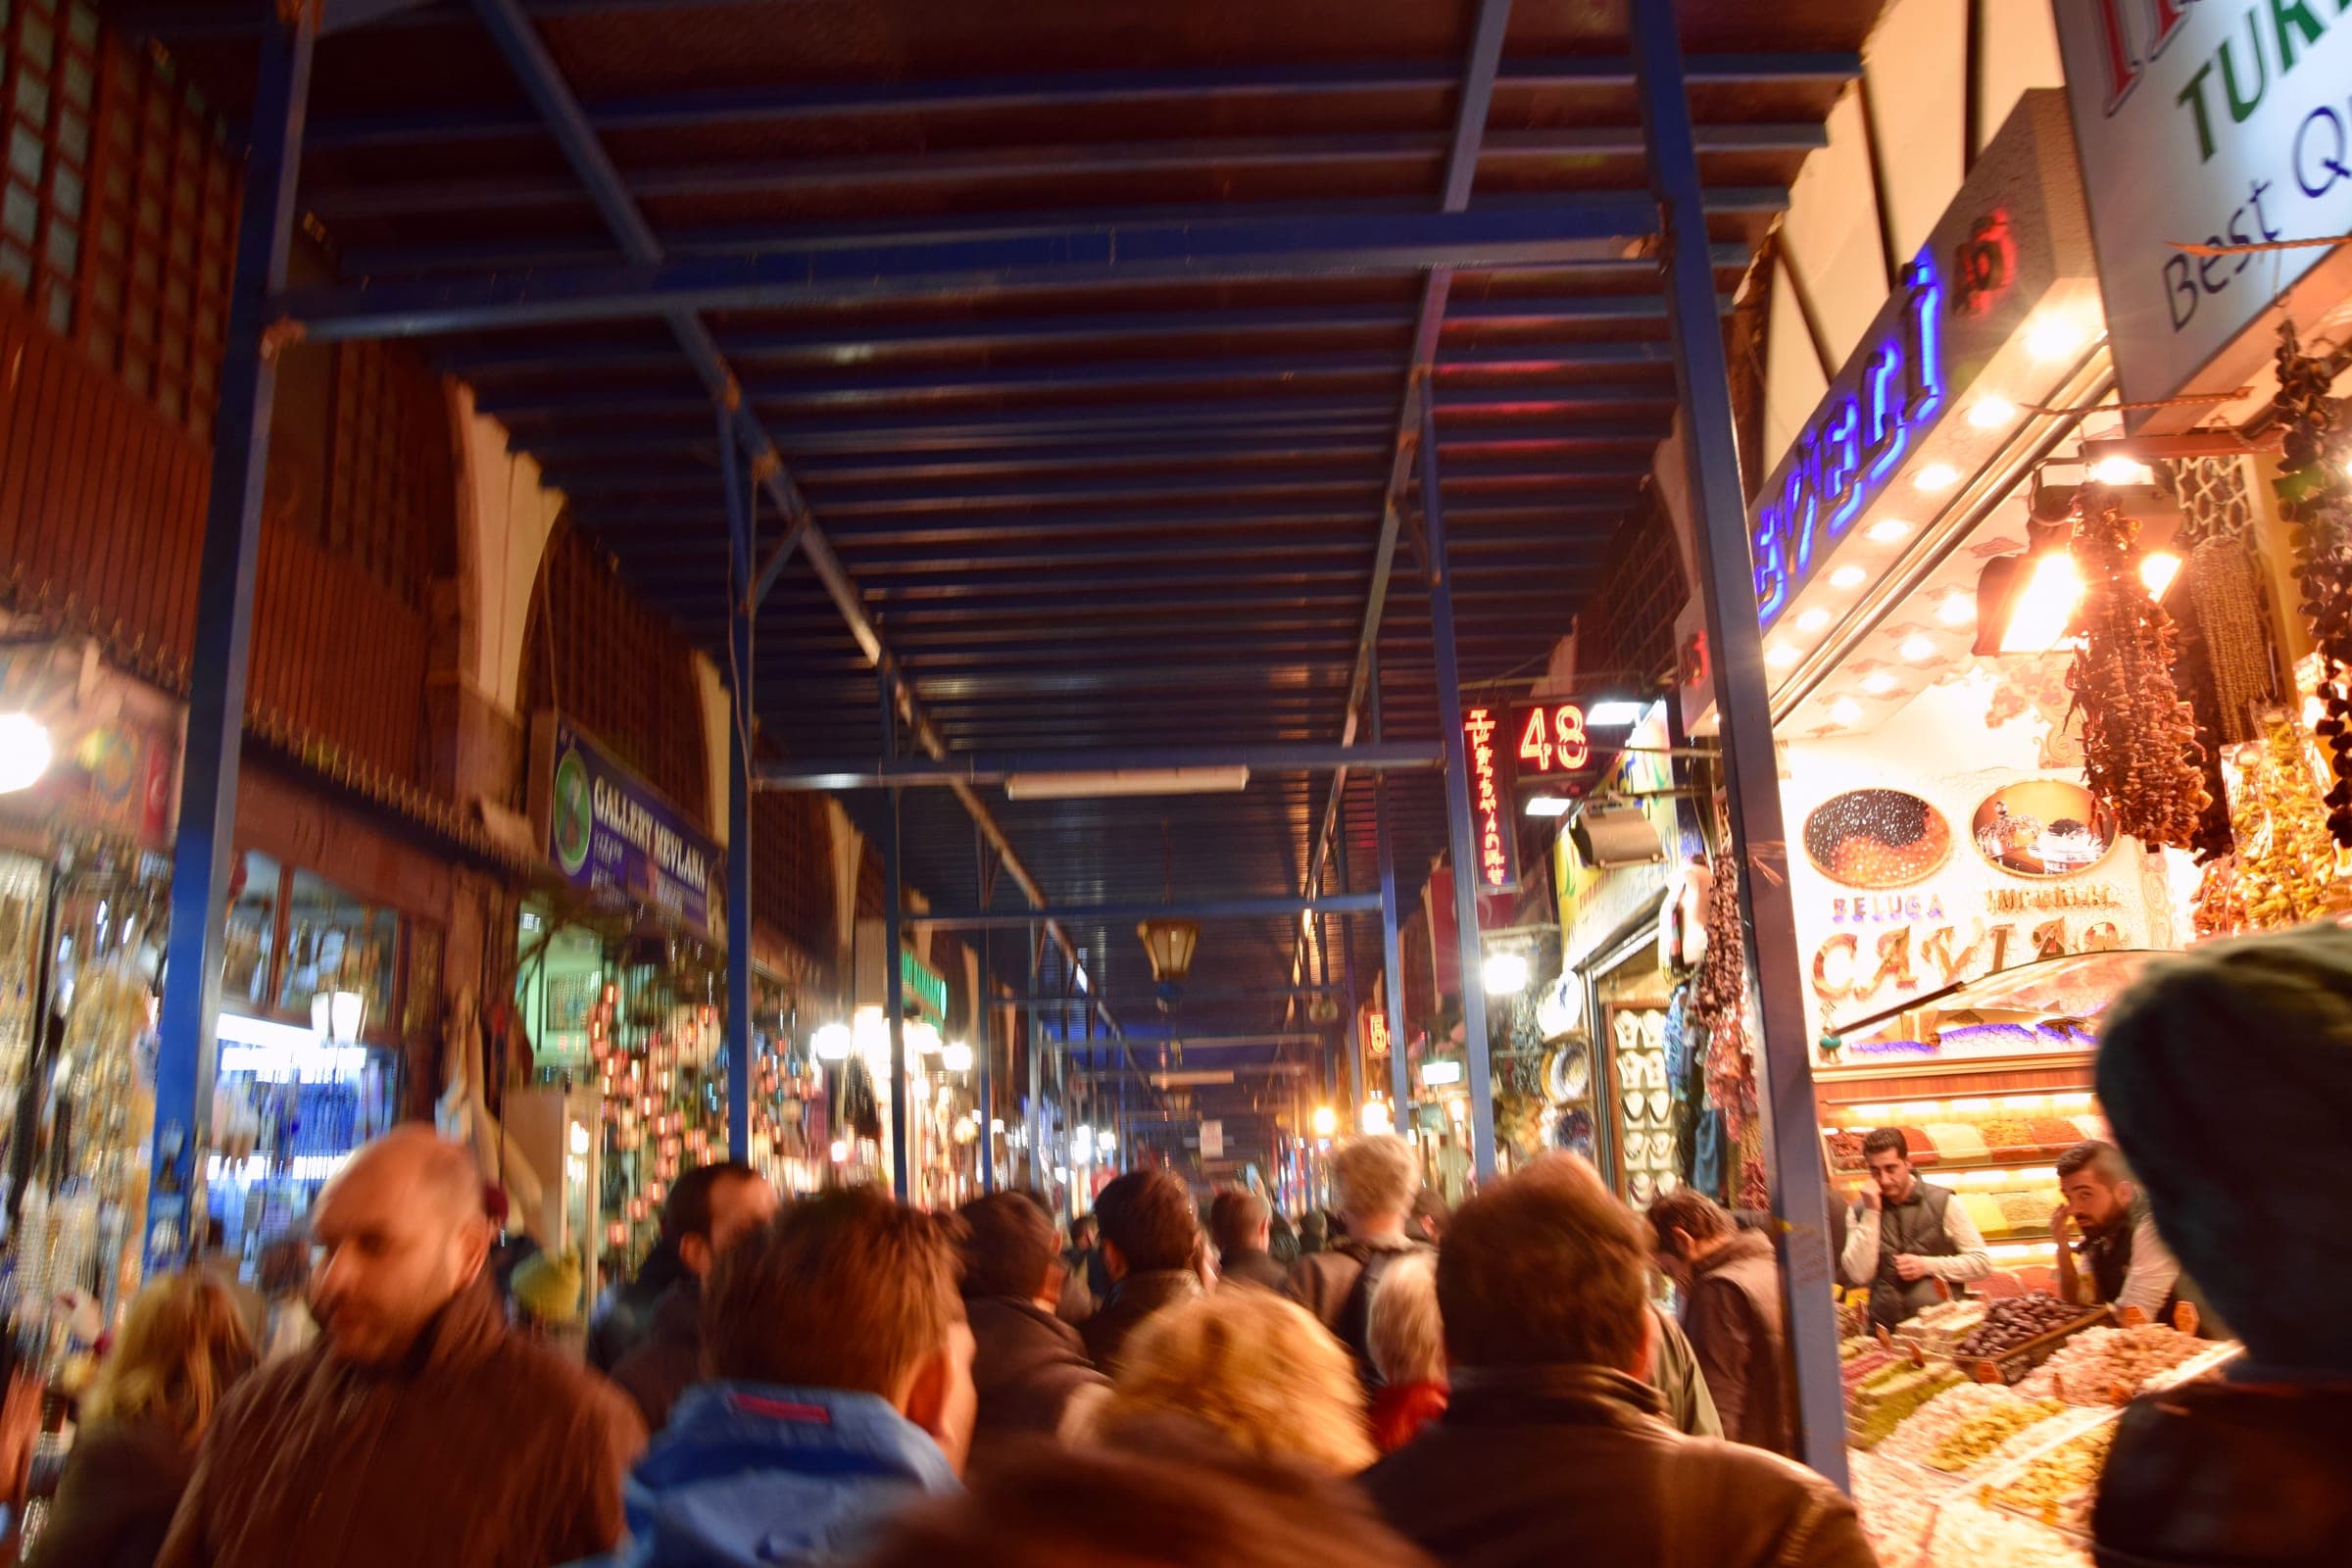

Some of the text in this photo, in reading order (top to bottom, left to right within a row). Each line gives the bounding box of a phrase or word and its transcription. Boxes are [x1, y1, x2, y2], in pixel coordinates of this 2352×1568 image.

[2177, 0, 2352, 165] TUR
[2291, 95, 2352, 198] Q
[1520, 705, 1589, 771] 48
